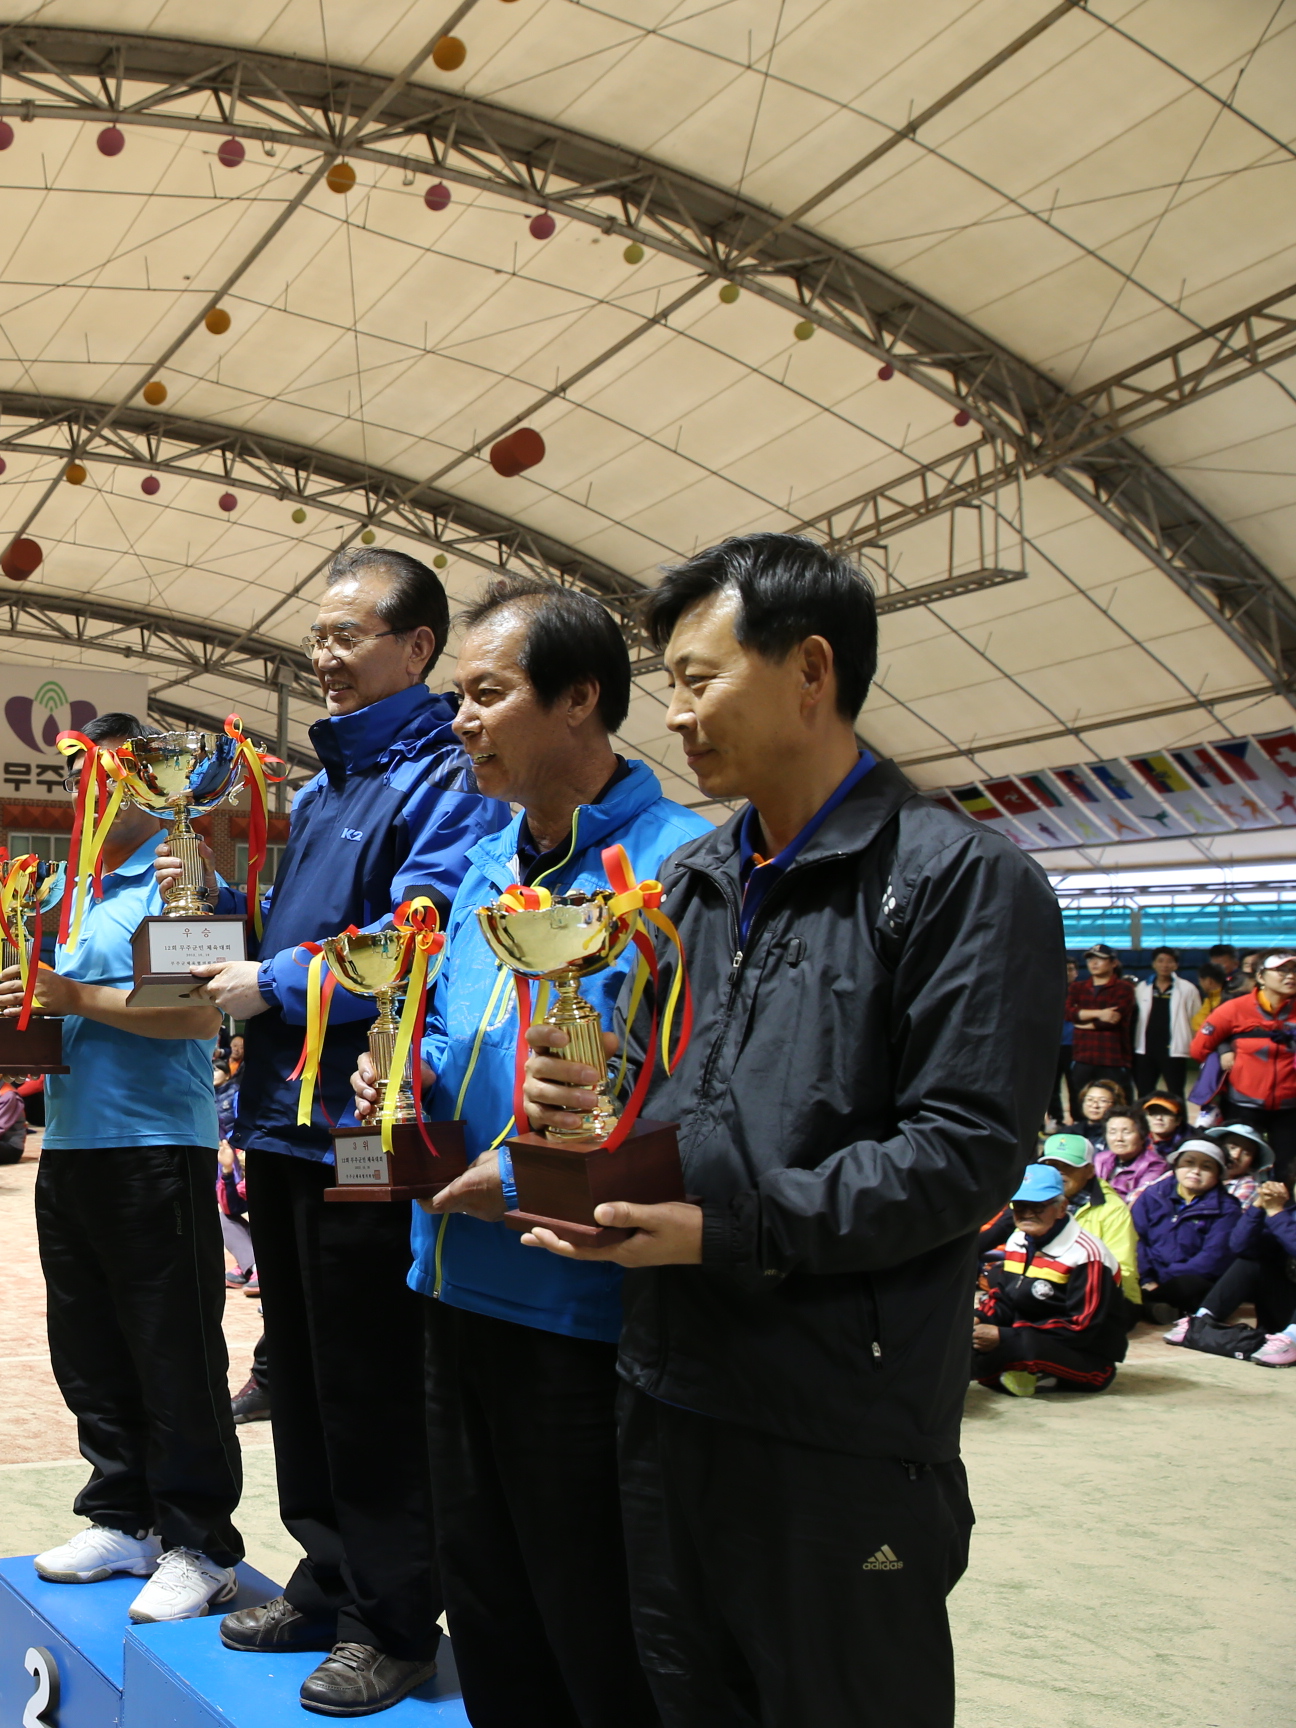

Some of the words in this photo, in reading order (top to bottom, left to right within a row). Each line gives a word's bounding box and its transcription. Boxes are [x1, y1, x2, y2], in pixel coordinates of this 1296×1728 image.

[3, 762, 65, 794] 무주
[341, 827, 363, 842] K2
[863, 1560, 903, 1570] adidas
[23, 1646, 54, 1728] 2
